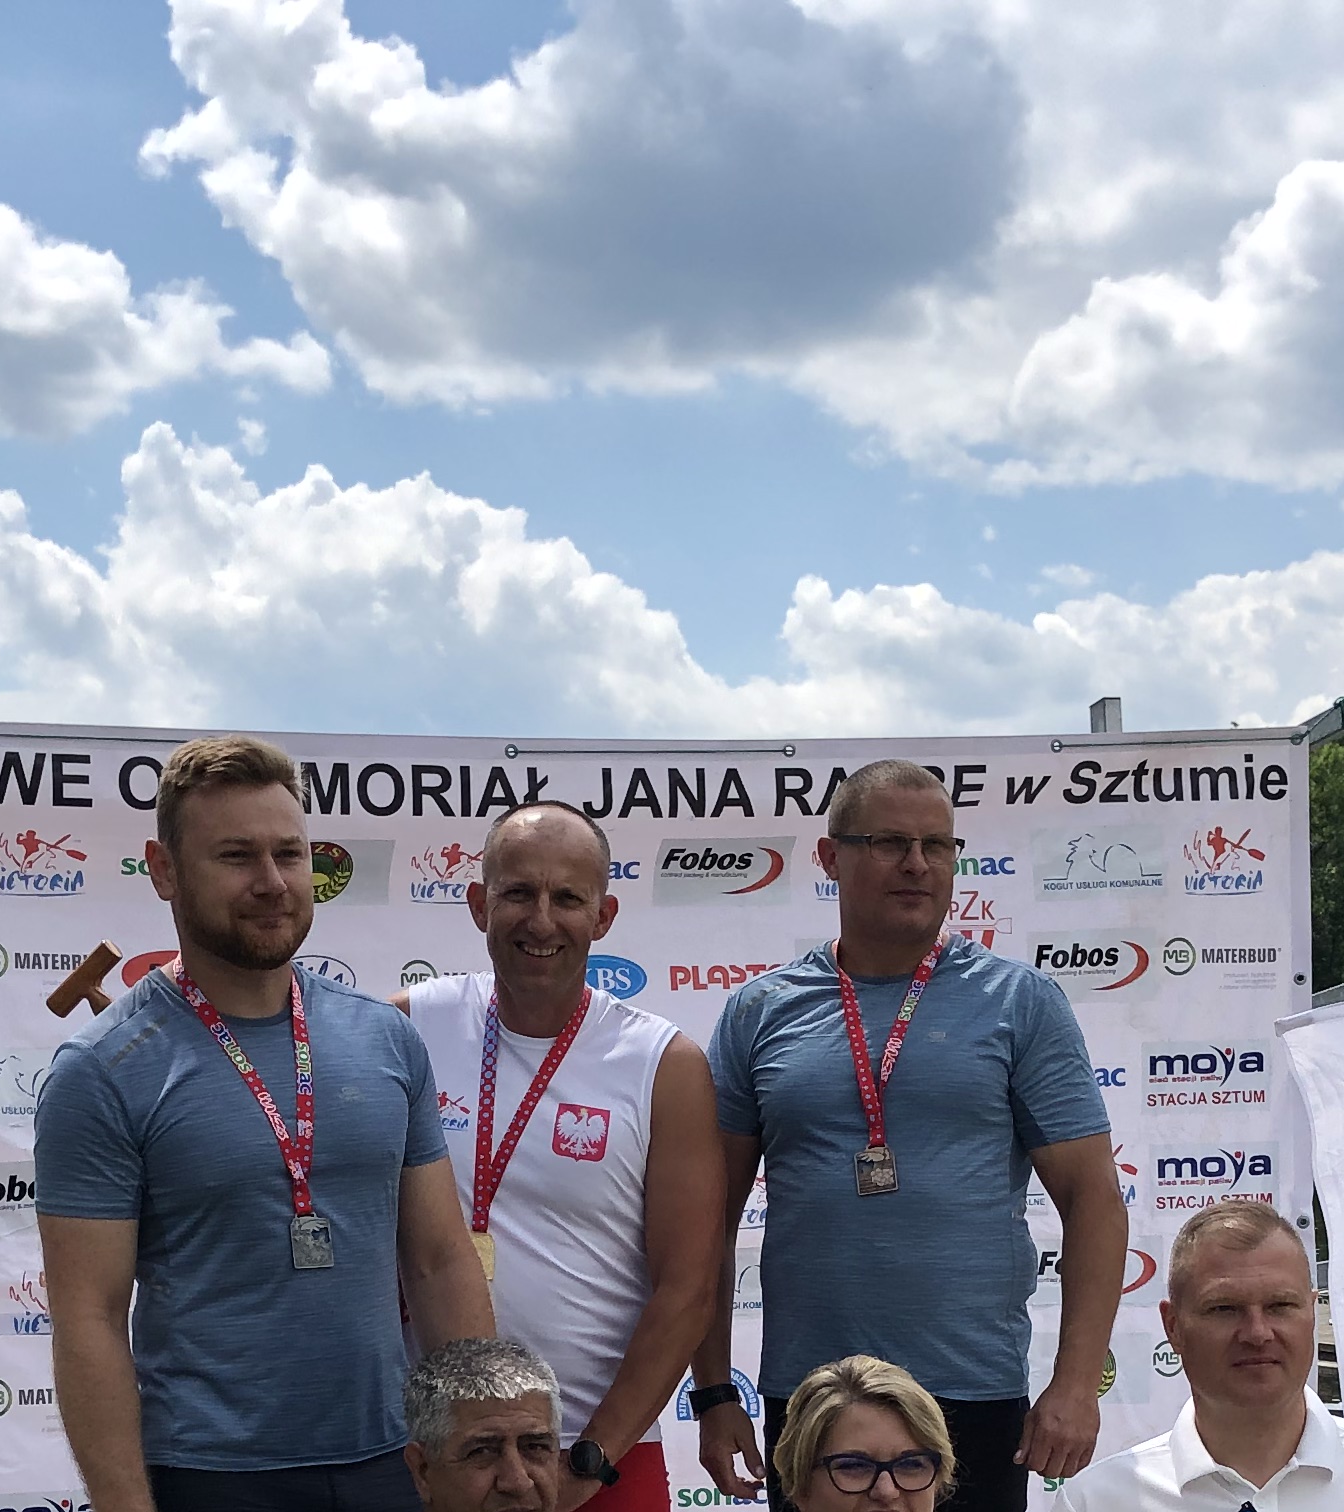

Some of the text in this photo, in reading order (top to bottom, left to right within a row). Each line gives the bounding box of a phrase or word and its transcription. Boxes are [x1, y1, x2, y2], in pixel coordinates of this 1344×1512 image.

[304, 762, 549, 818] MORIAŁ
[584, 767, 754, 818] JANA
[1006, 775, 1050, 804] w
[1063, 754, 1288, 804] Sztumie
[661, 848, 754, 870] Fobos
[1044, 879, 1163, 891] KOGUT USŁUGI KOMUNALNE
[949, 890, 995, 921] PZK
[1036, 943, 1118, 969] Fobos
[1202, 948, 1278, 964] MATERBUD
[898, 979, 925, 1021] sonac
[210, 1021, 254, 1074] sonac
[295, 1040, 312, 1096] sonac
[1149, 1045, 1264, 1086] moya
[1147, 1090, 1265, 1107] STACJA SZTUM
[1157, 1148, 1271, 1190] moya
[1156, 1195, 1215, 1208] STACJA
